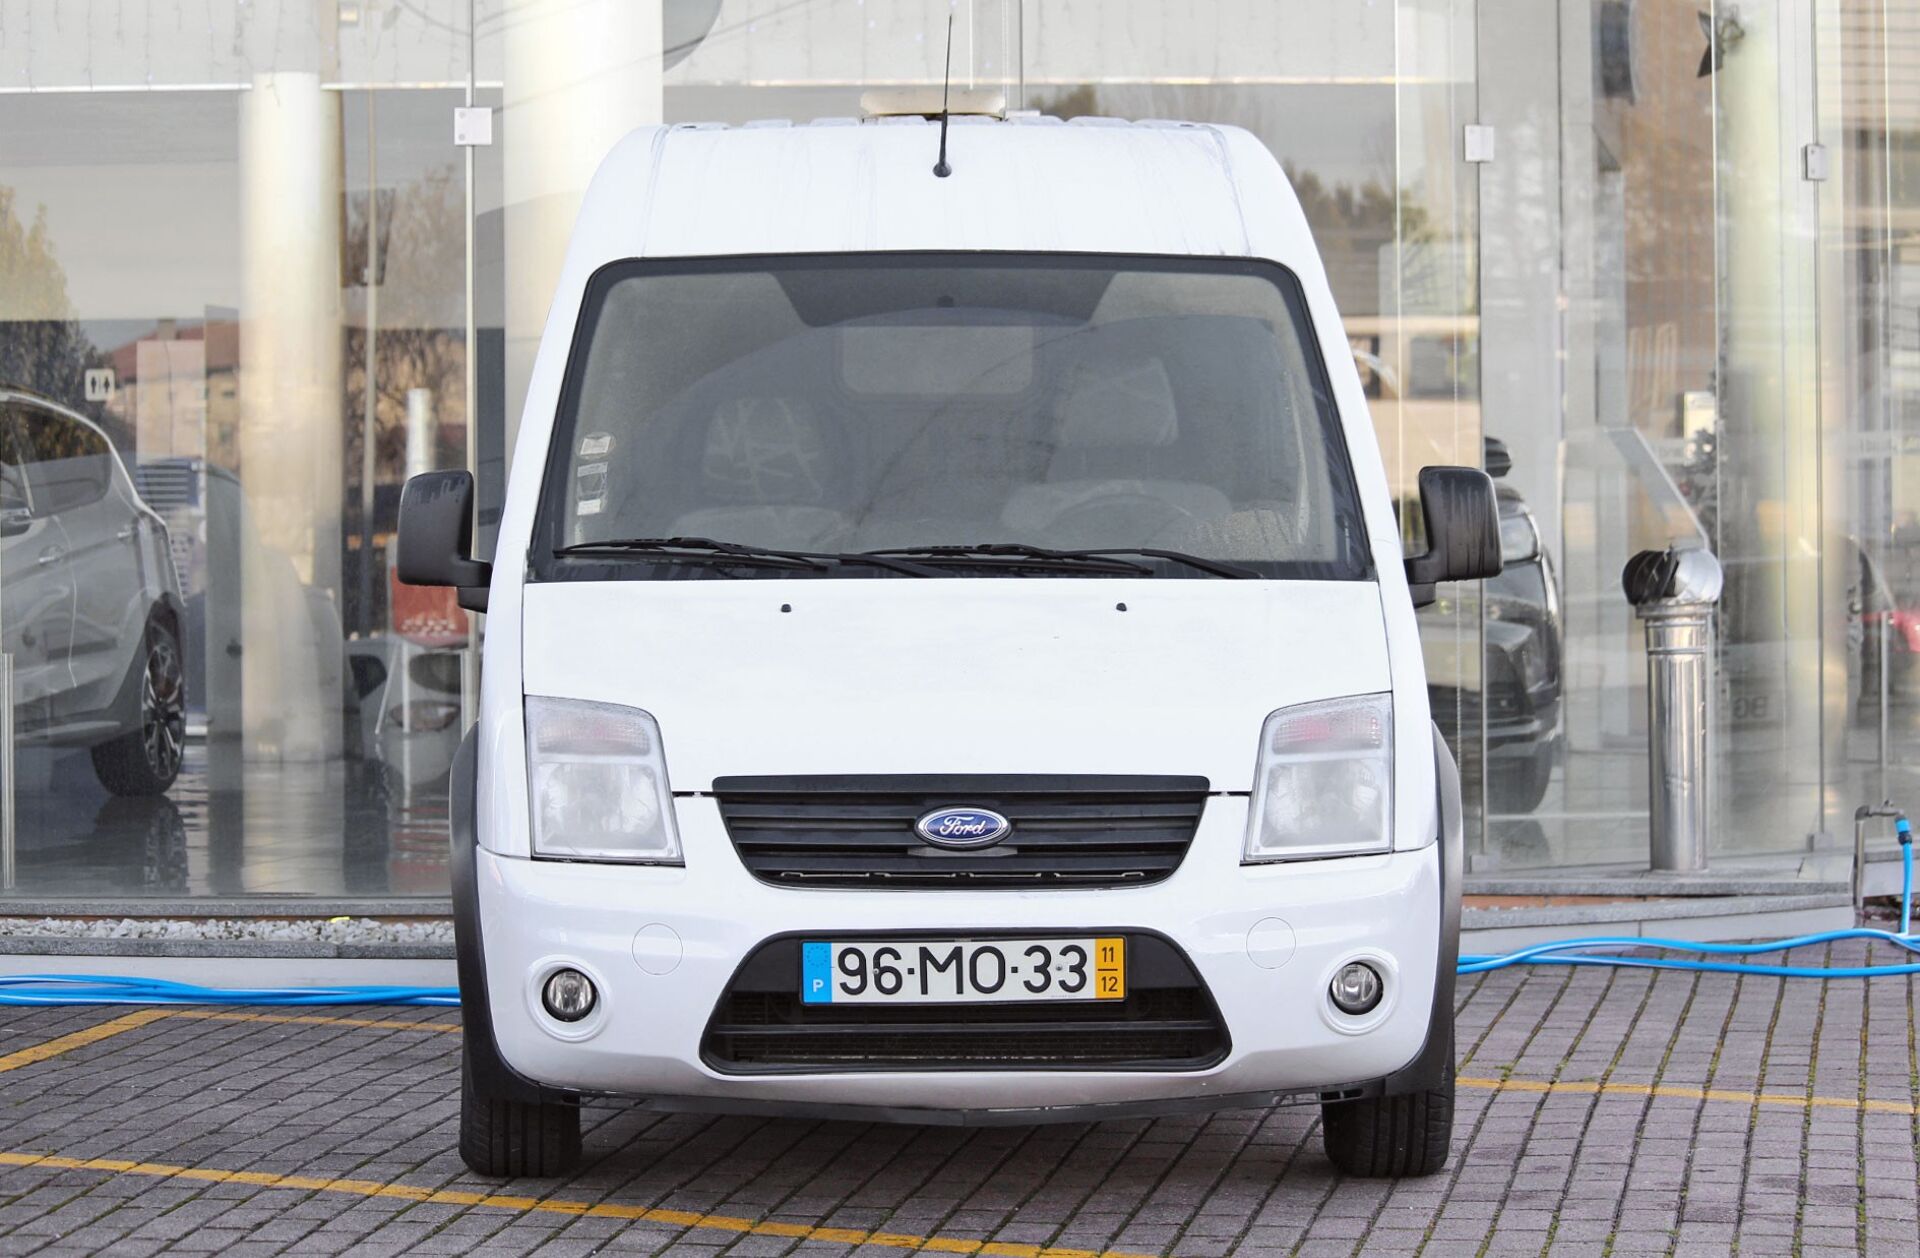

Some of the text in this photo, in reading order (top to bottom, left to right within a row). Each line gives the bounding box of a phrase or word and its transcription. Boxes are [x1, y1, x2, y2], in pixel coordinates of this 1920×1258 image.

[939, 815, 986, 835] Ford
[1102, 946, 1115, 963] 11
[812, 979, 824, 993] P
[1101, 976, 1118, 992] 12
